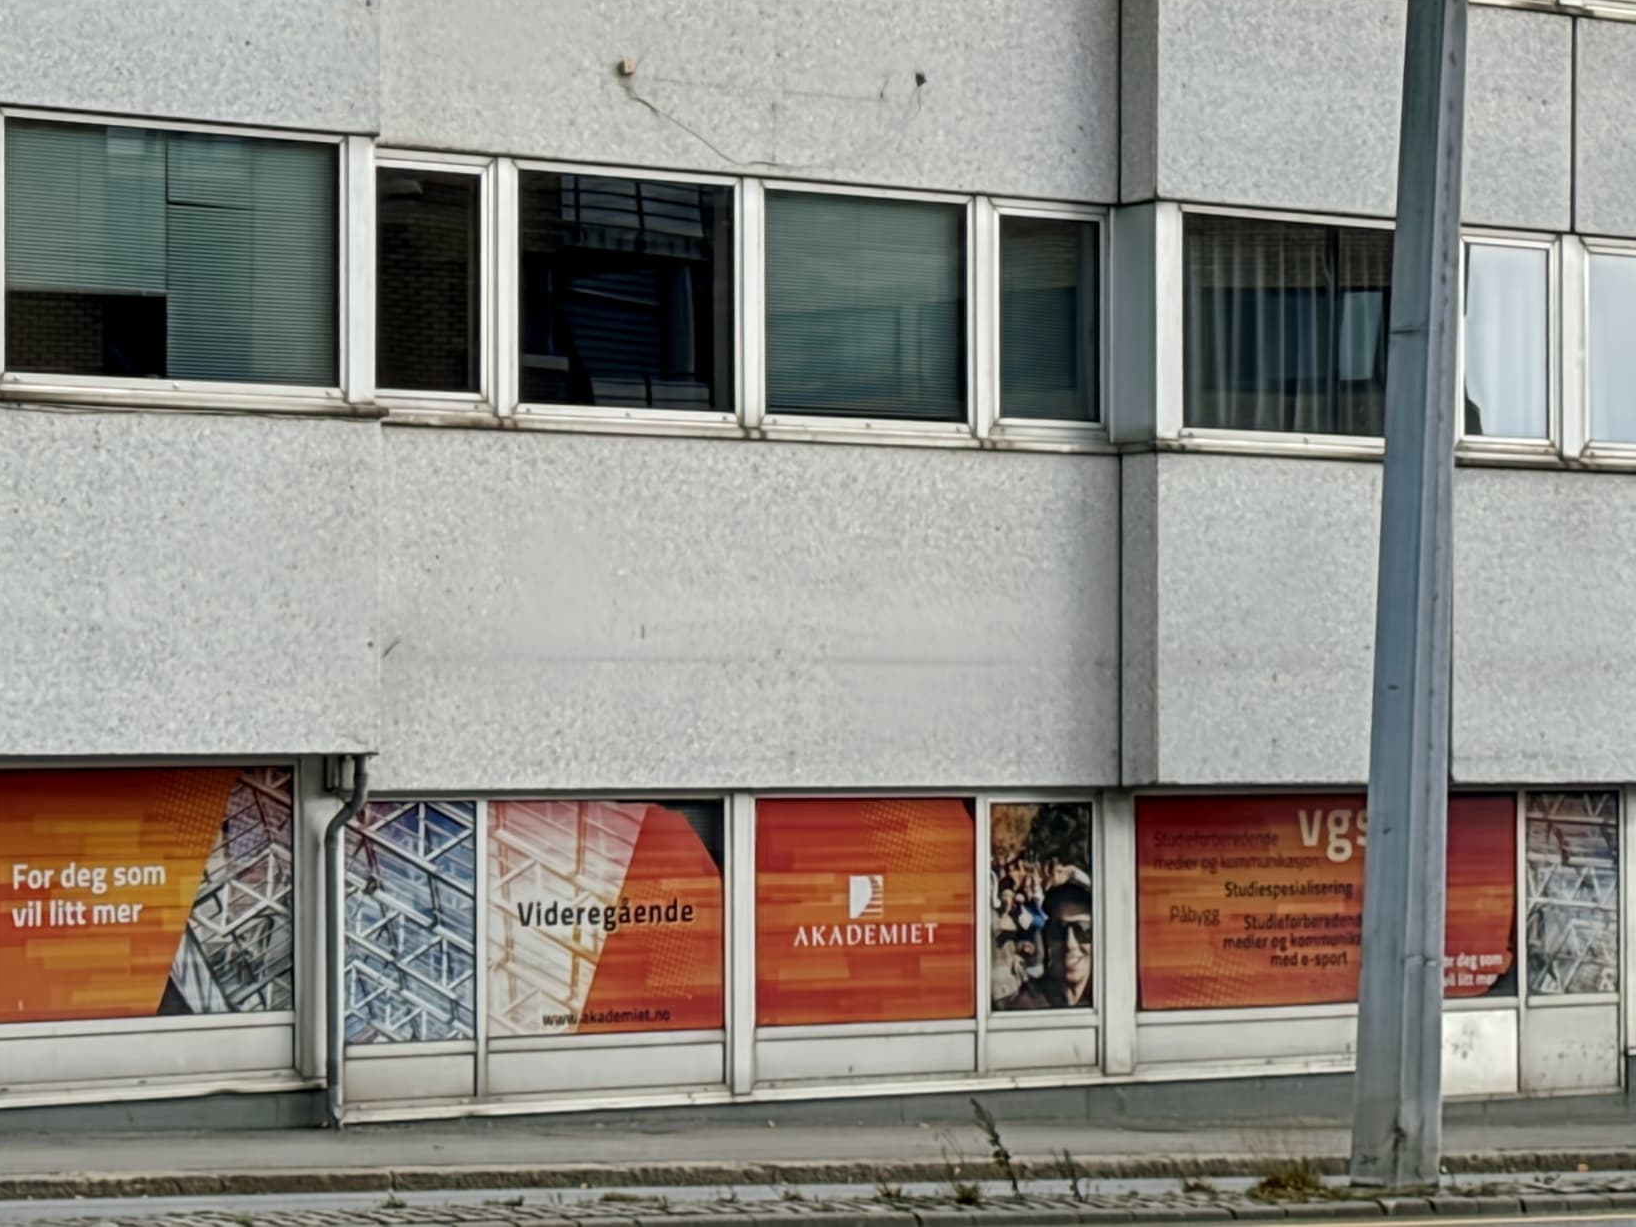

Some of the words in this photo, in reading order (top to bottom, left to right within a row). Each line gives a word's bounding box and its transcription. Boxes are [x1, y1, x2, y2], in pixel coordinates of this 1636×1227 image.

[12, 863, 55, 891] For
[60, 861, 108, 895] deg
[113, 864, 167, 887] som
[1224, 880, 1354, 900] Studiespesialisering
[12, 899, 42, 928] vil
[49, 899, 86, 927] litt
[91, 902, 143, 925] mer
[517, 897, 694, 932] Videregående
[1169, 904, 1221, 928] Påbygg
[1243, 912, 1362, 931] Studieforberedend
[793, 922, 939, 948] AKADEMIET
[1222, 935, 1269, 950] medier
[1270, 936, 1288, 952] og
[1269, 951, 1298, 967] med
[1300, 950, 1348, 969] e-sport
[542, 1009, 672, 1026] www.akademiet.no
